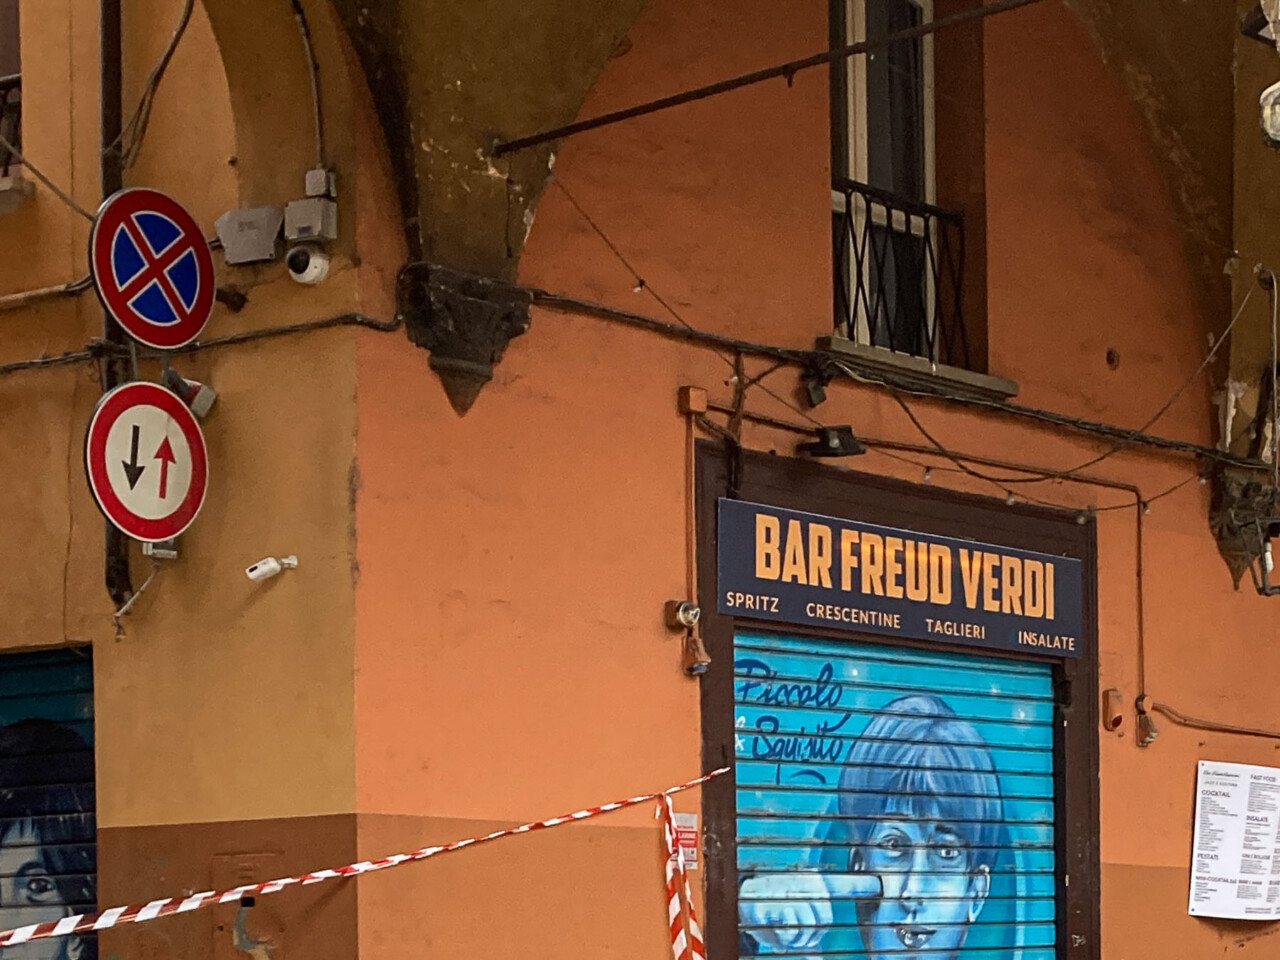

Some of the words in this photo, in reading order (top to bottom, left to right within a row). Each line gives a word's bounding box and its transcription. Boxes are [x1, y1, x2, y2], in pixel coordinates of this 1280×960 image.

[755, 513, 832, 588] BAR
[841, 529, 951, 605] FREUD
[959, 548, 1055, 620] VERDI
[726, 591, 779, 613] SPRITZ
[806, 603, 901, 629] CRESCENTINE
[925, 618, 985, 640] TAGLIERI
[1018, 630, 1075, 651] INSALATE
[734, 658, 843, 708] Piccolo
